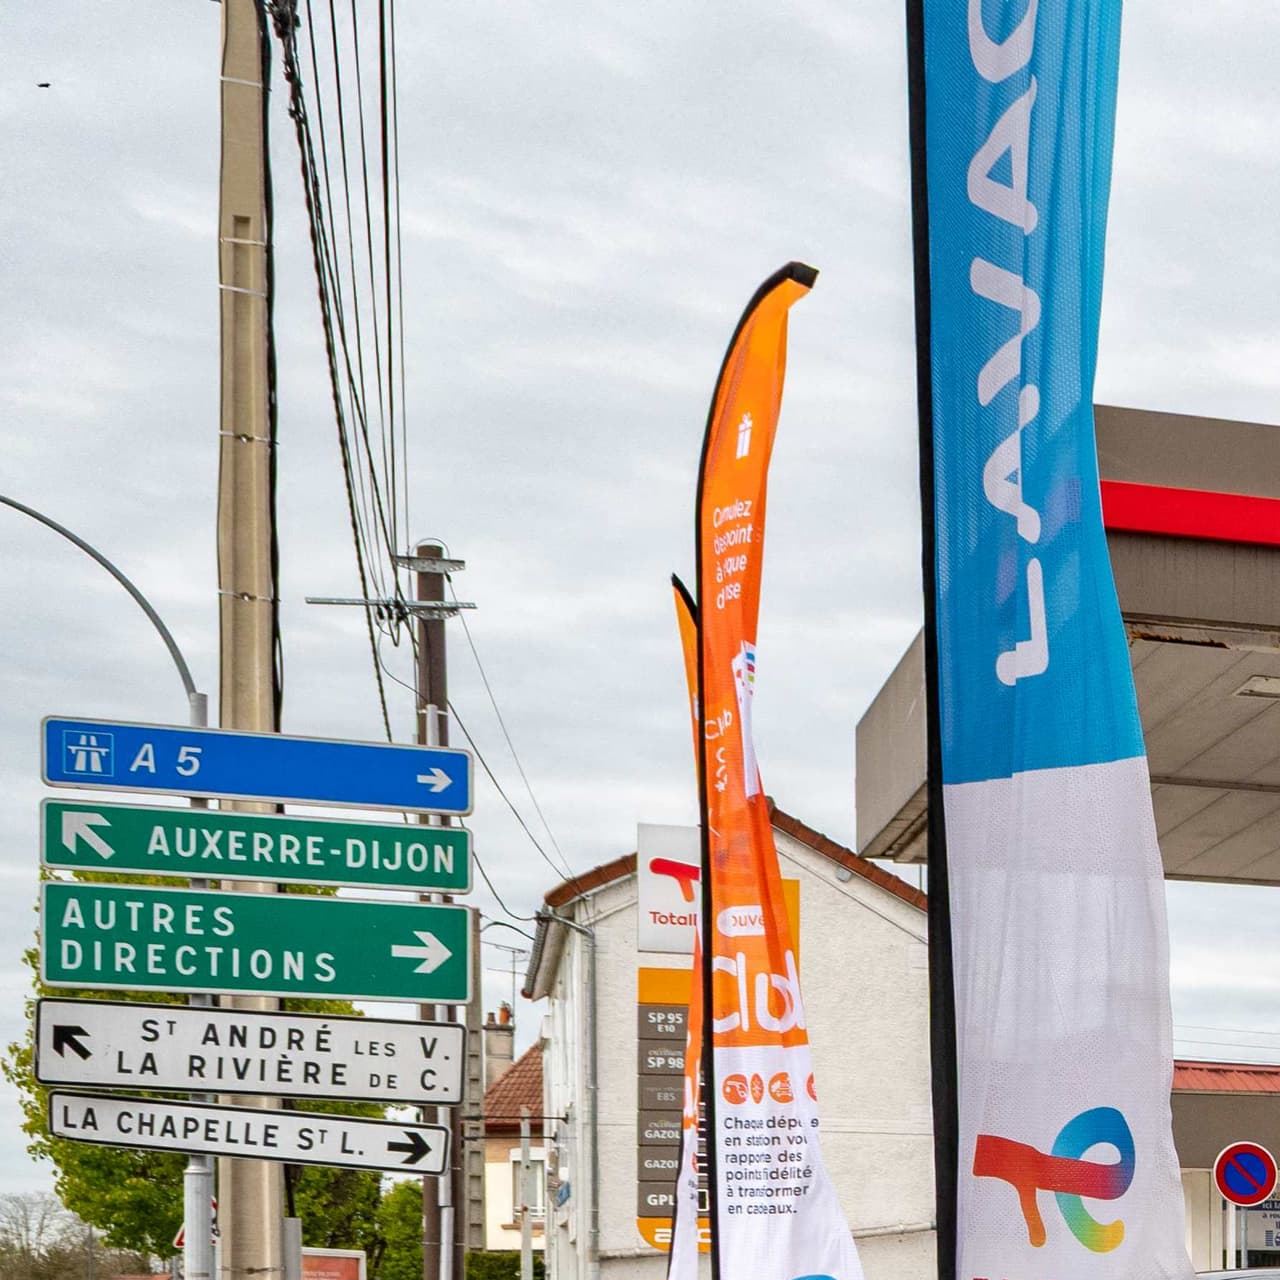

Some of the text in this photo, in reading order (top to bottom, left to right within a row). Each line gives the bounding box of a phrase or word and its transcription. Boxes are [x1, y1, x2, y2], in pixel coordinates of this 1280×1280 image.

[130, 743, 202, 776] A 5
[147, 825, 454, 874] AUXERRE-DIJON
[61, 898, 235, 937] AUTRES
[60, 938, 337, 983] DIRECTIONS
[647, 1012, 684, 1024] SP 95
[657, 1024, 676, 1033] E10
[201, 1024, 332, 1053] ANDRÉ
[354, 1040, 396, 1057] LES
[420, 1036, 450, 1060] V.
[117, 1051, 449, 1092] LA RIVIÈRE DE C.
[647, 1057, 685, 1069] SP 98
[63, 1105, 99, 1131] LA
[116, 1111, 279, 1148] CHAPELLE
[340, 1131, 365, 1156] L.
[725, 1136, 741, 1147] en
[777, 1150, 803, 1163] des
[728, 1204, 743, 1215] en
